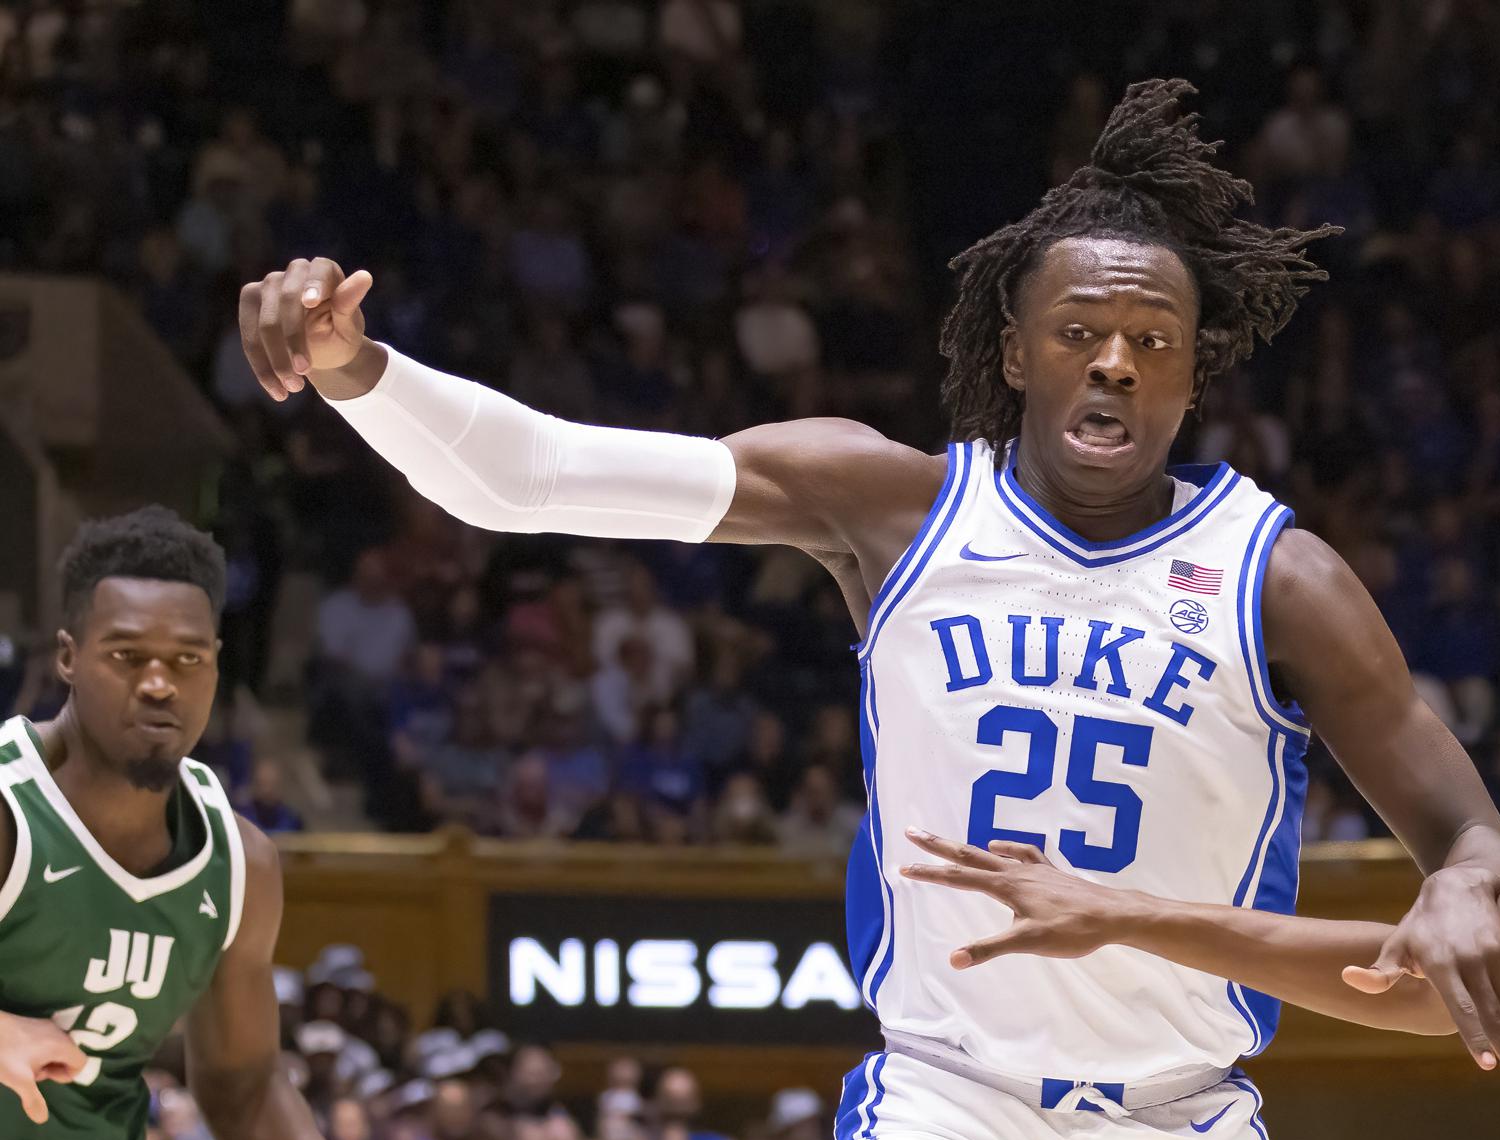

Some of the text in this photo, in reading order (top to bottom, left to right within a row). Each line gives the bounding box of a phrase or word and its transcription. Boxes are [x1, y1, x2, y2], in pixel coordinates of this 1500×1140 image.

[930, 614, 1218, 727] DUKE
[967, 705, 1154, 873] 25
[84, 928, 174, 999] JU
[52, 1002, 138, 1086] 2
